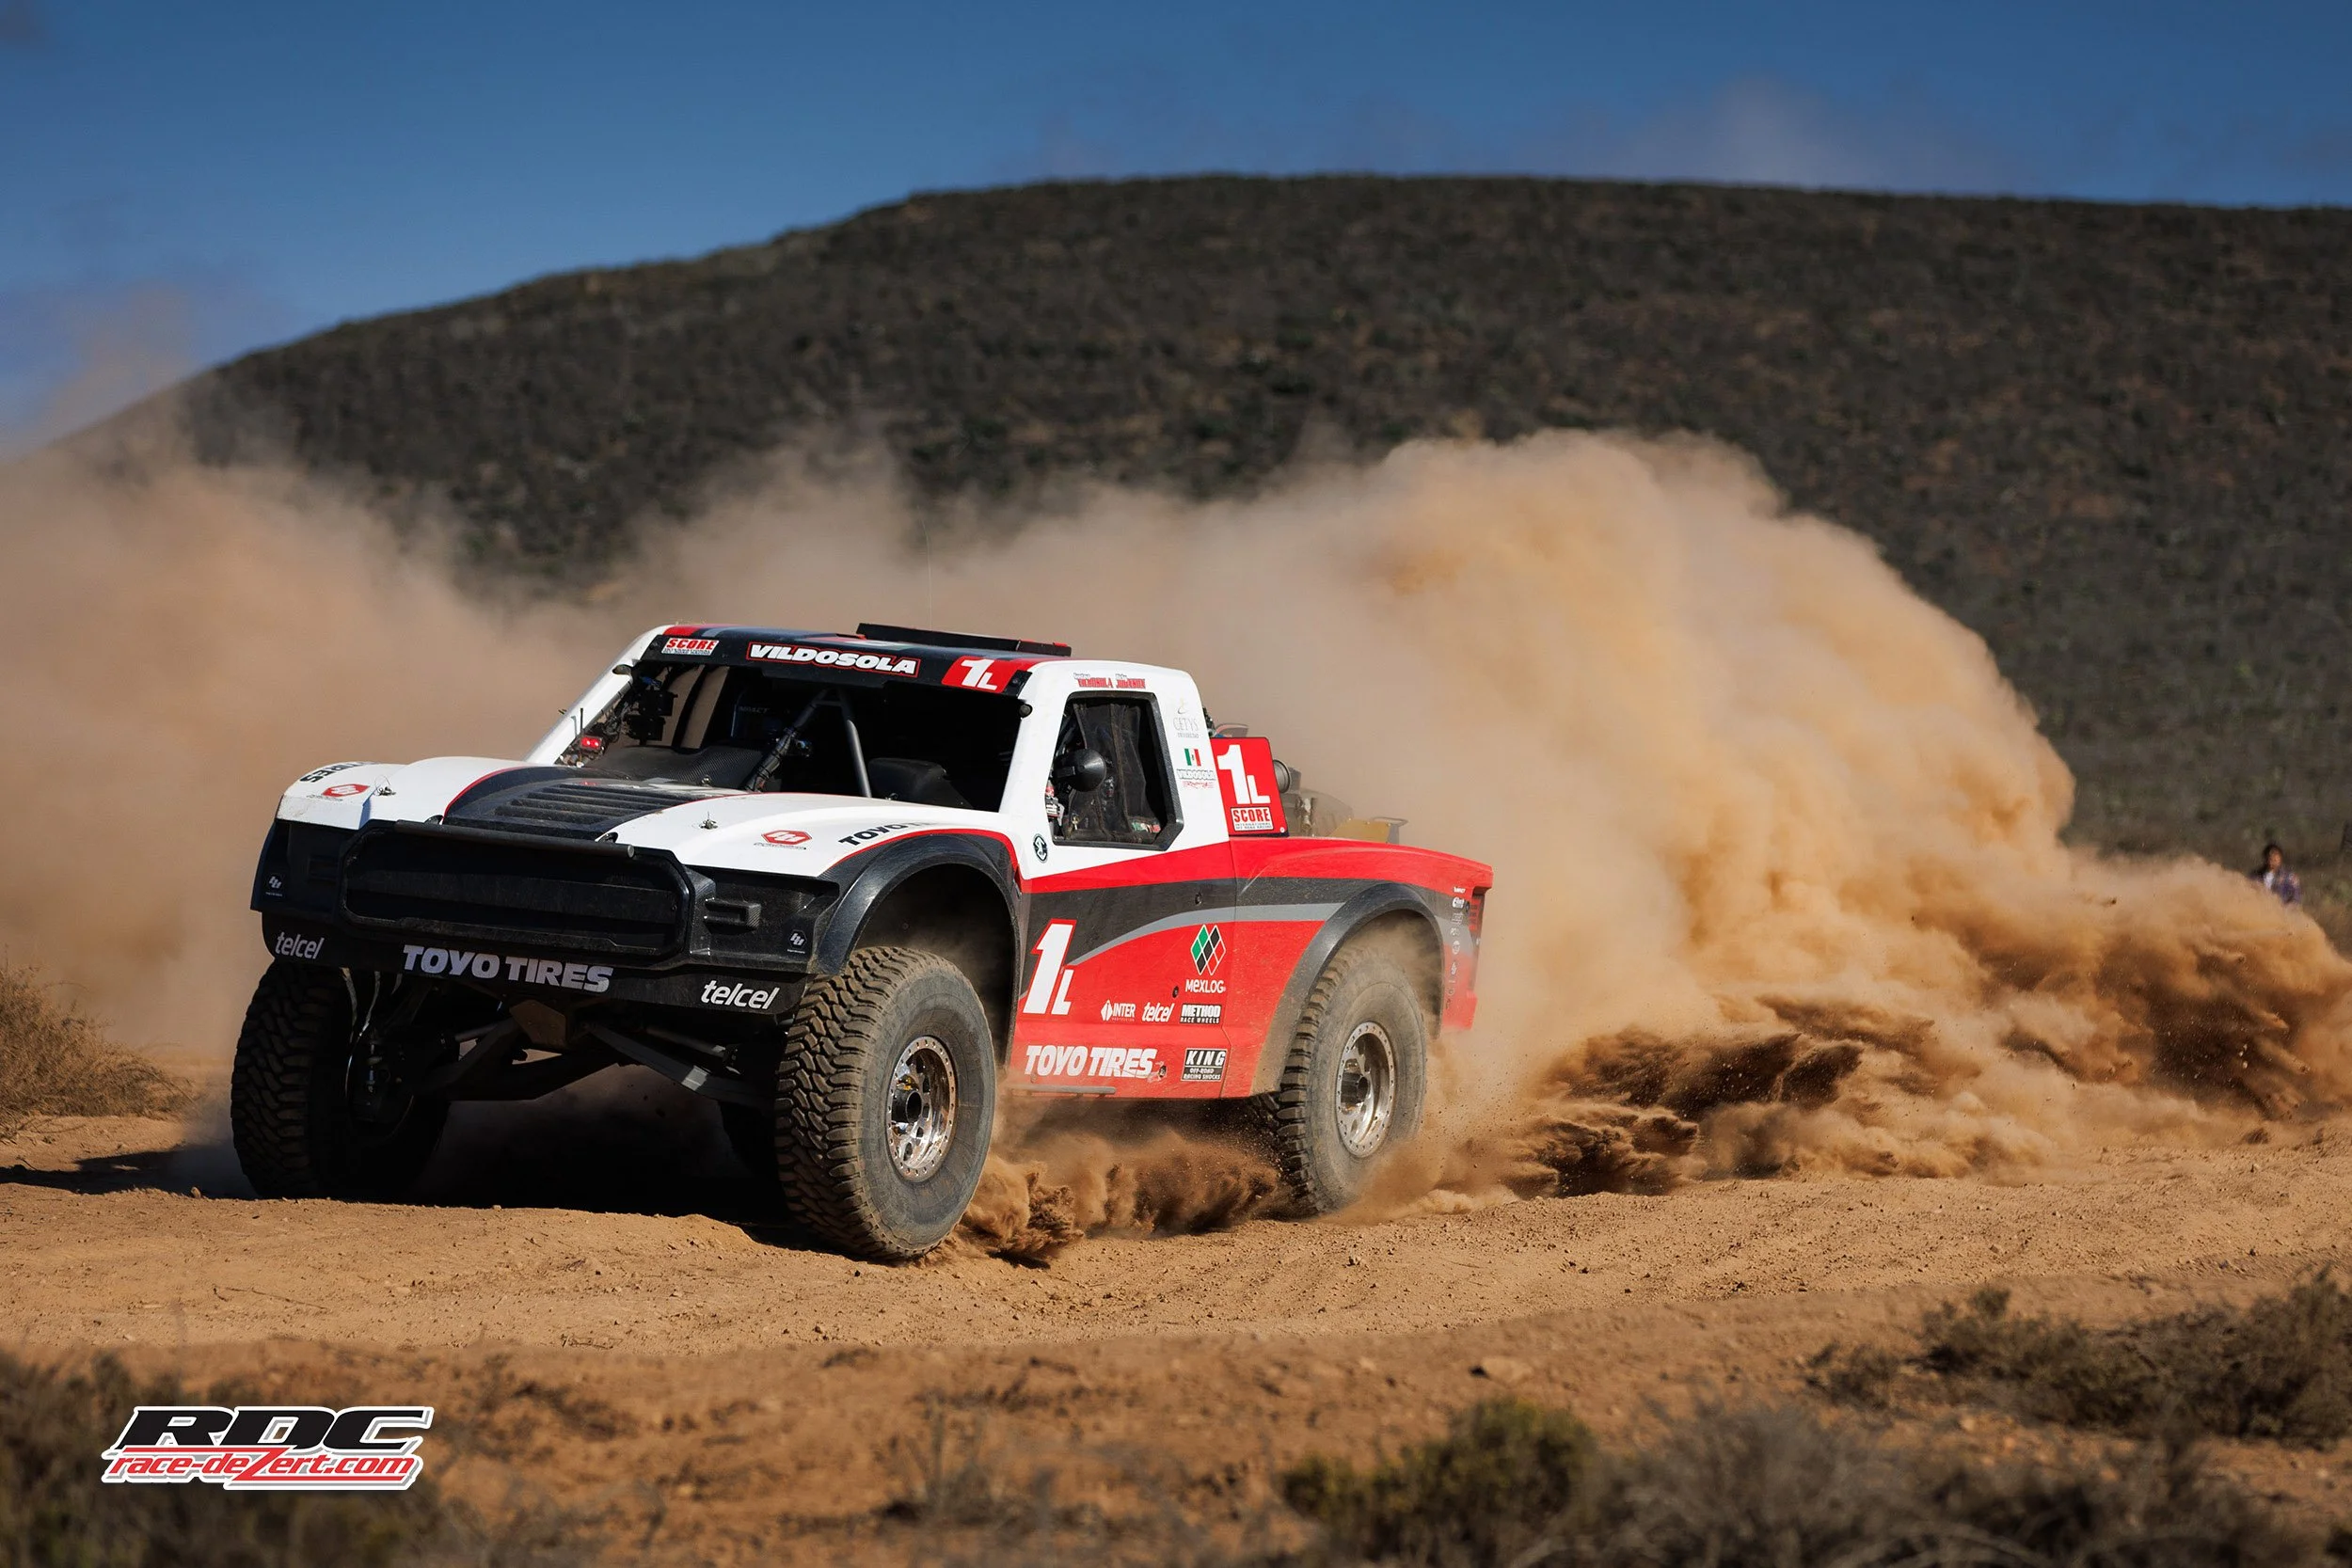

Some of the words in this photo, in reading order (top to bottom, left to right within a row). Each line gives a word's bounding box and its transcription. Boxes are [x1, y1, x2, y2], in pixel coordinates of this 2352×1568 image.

[666, 639, 717, 650] SCORE
[750, 644, 917, 674] VILDOSOLA
[954, 658, 1000, 691] 1L
[1216, 744, 1271, 804] 1L
[1232, 808, 1271, 823] SCORE
[837, 823, 909, 847] TOYO
[275, 931, 326, 959] telcel
[402, 944, 501, 979] TOYO
[504, 956, 614, 993] TIRES
[1022, 923, 1075, 1017] 1L
[700, 979, 781, 1010] telcel
[1112, 1003, 1136, 1018] INTER
[1141, 1002, 1175, 1022] telcel
[1181, 1004, 1221, 1018] METHOD
[1024, 1045, 1089, 1077] TOYO
[1088, 1046, 1159, 1080] TIRES
[1185, 1050, 1226, 1067] KING
